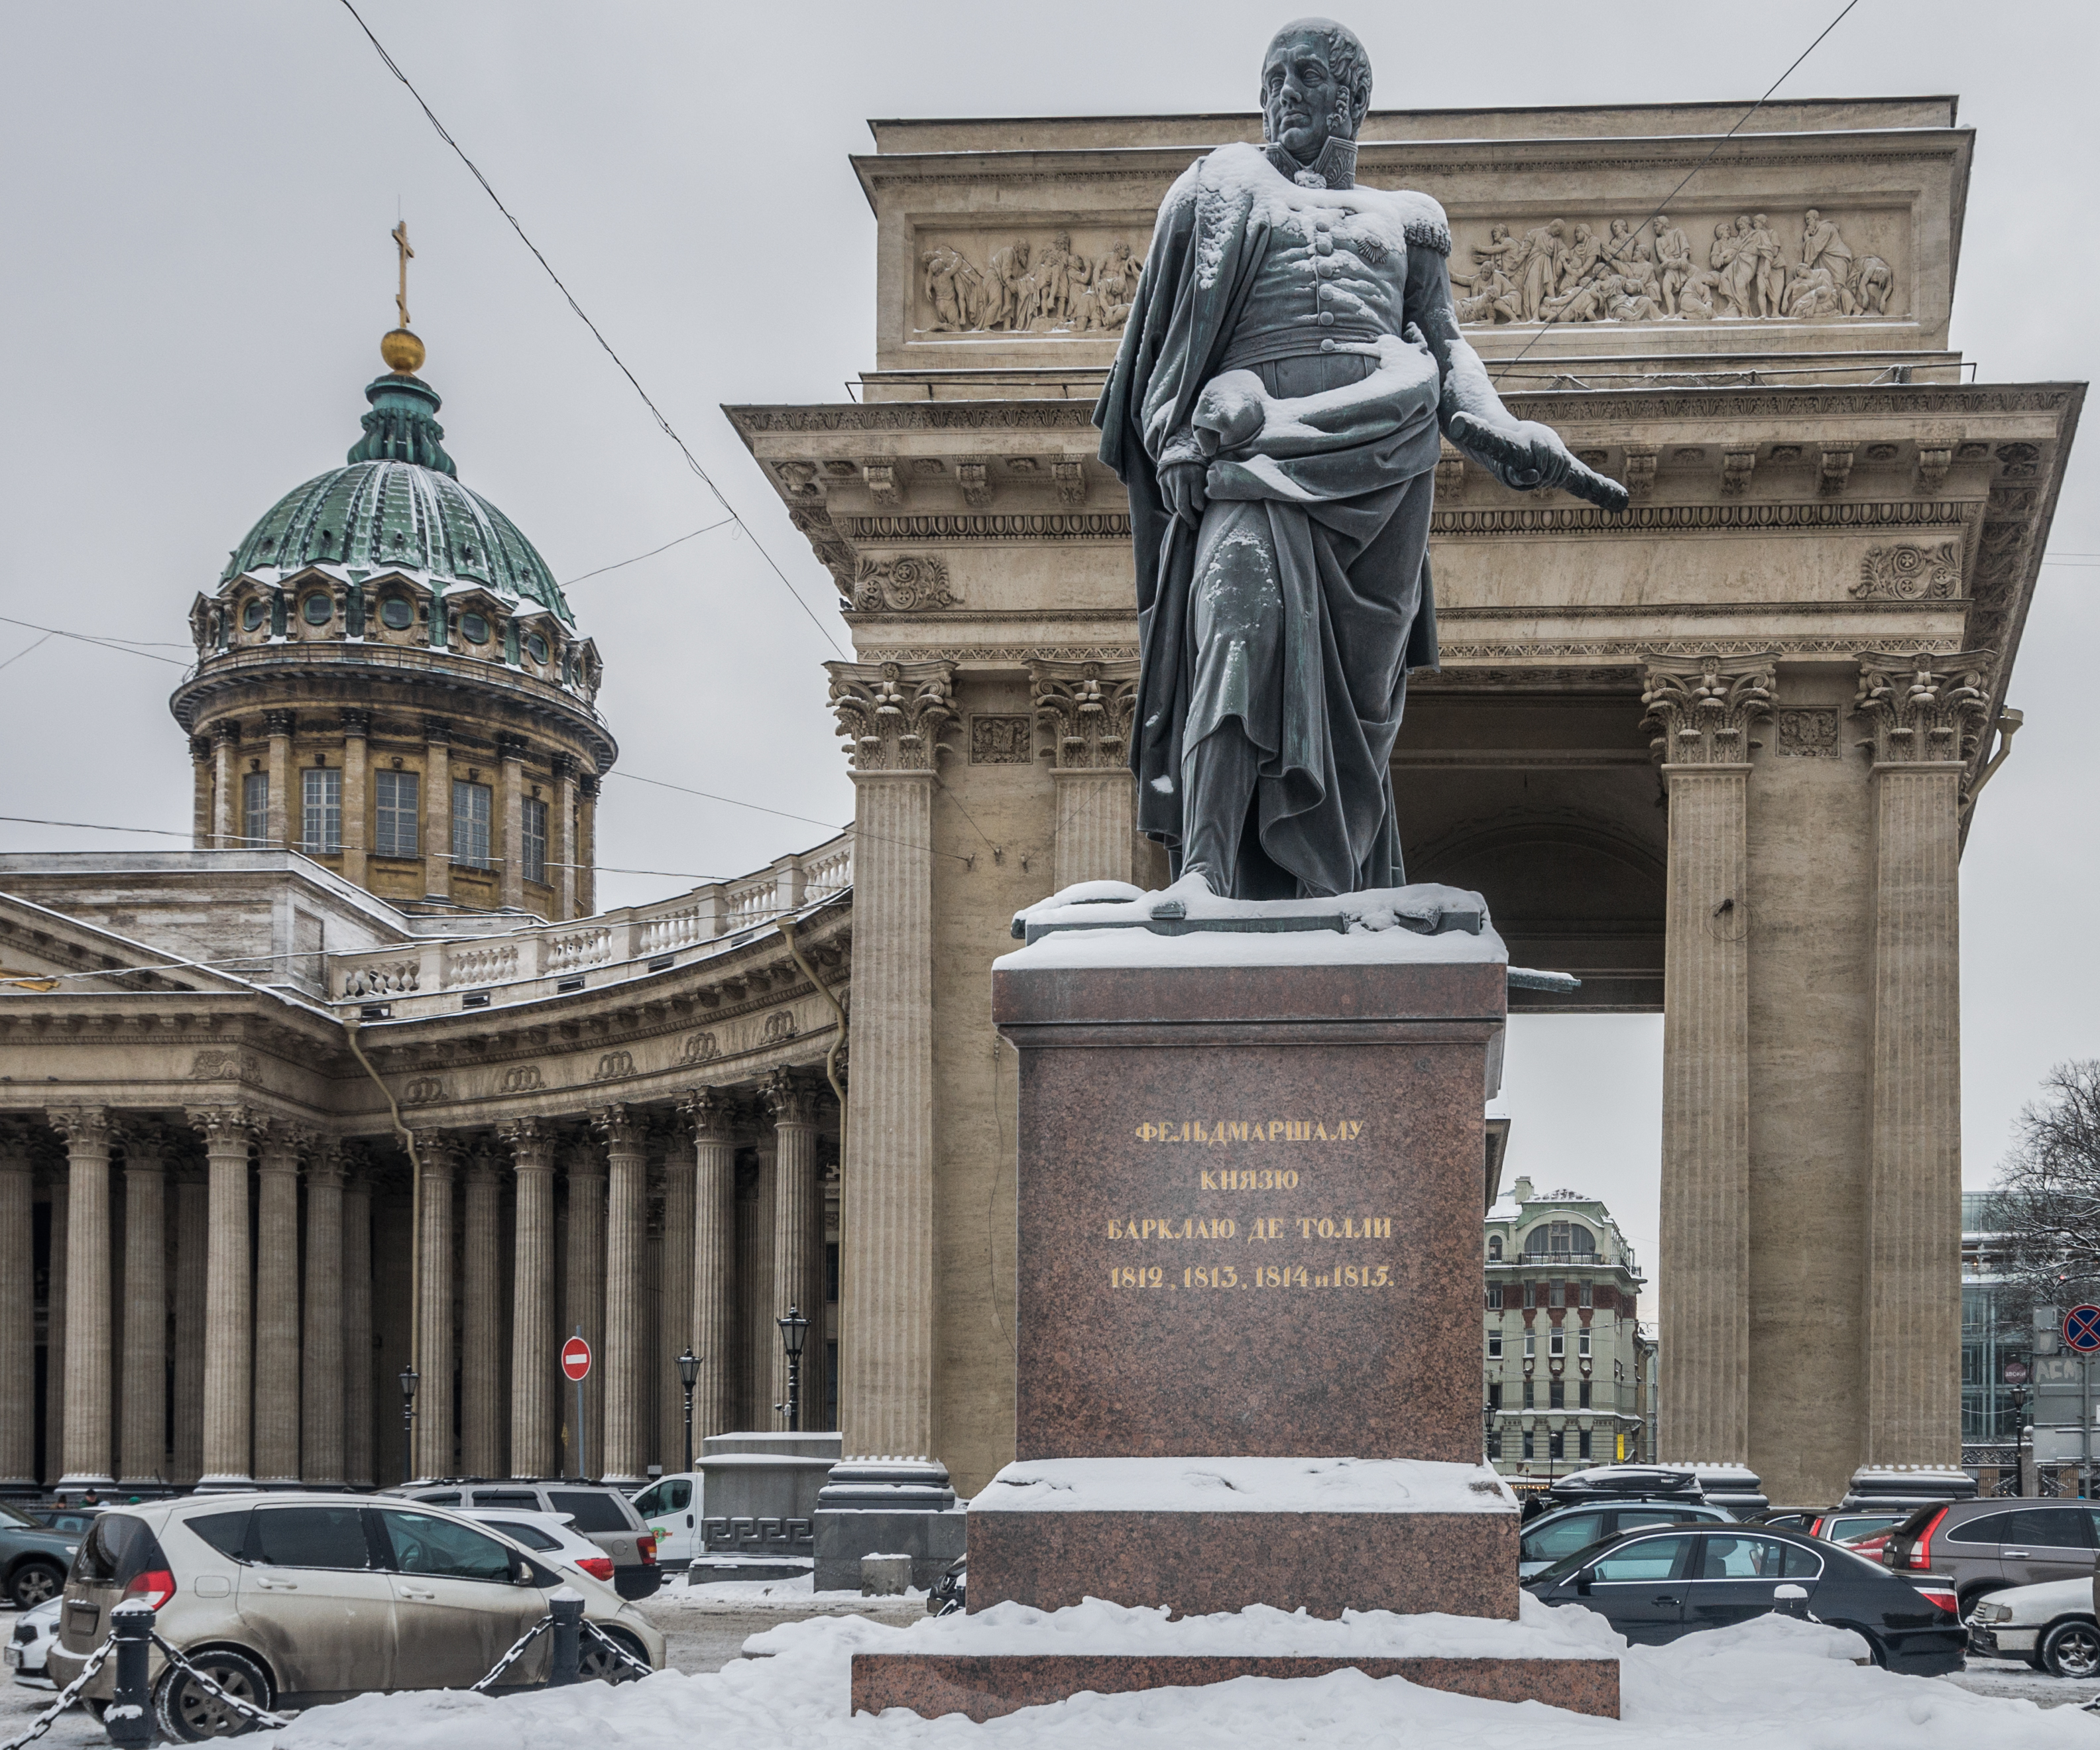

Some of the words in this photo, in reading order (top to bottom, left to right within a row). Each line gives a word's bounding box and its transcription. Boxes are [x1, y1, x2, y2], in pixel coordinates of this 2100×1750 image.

[1136, 1120, 1364, 1147] ФЕЛЬДМАРШАЛУ
[1200, 1170, 1299, 1190] КНЯЗЮ
[1108, 1218, 1235, 1240] БАРКЛАЮ
[1248, 1218, 1283, 1244] ДЕ
[1296, 1218, 1391, 1239] ТОЛЛИ
[1184, 1266, 1247, 1290] 1813,
[1255, 1265, 1309, 1288] 1814
[1315, 1275, 1328, 1287] и
[1334, 1265, 1394, 1287] 1815.
